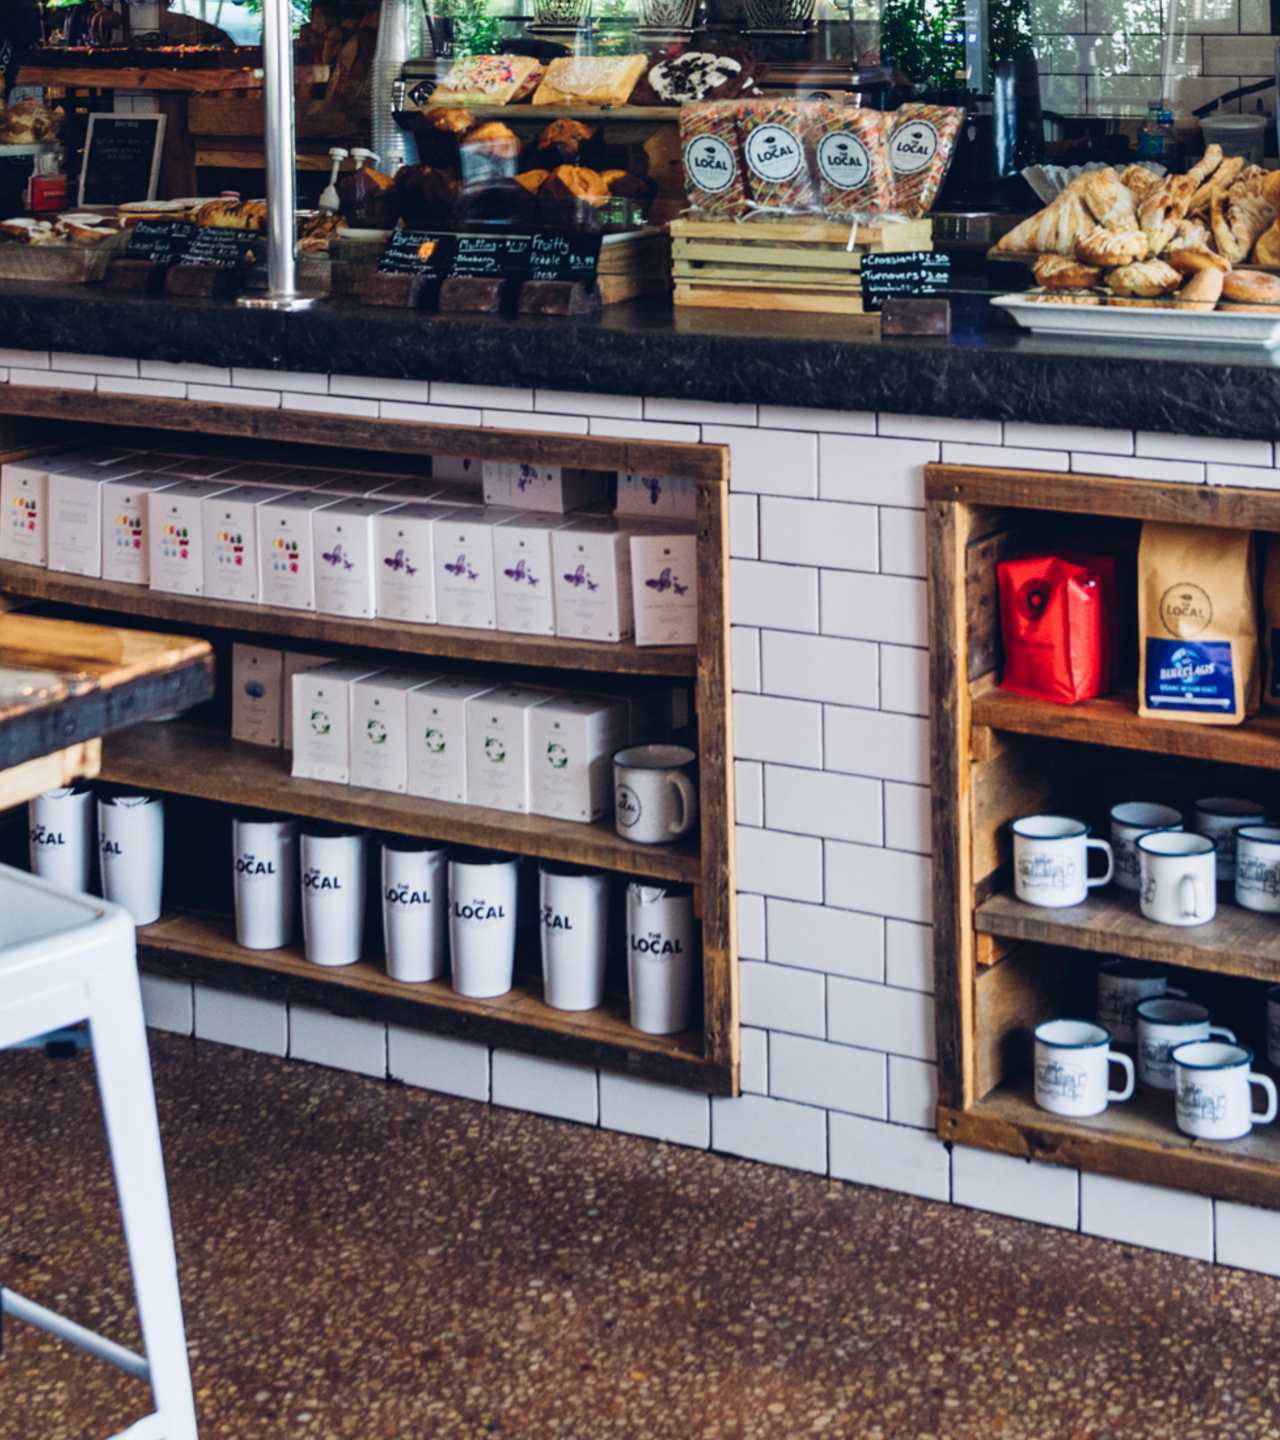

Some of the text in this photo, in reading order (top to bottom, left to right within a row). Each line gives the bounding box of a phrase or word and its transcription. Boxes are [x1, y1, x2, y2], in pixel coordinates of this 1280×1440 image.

[756, 147, 794, 163] LOCAL
[896, 141, 930, 156] LOCAL
[694, 157, 728, 171] LOCAL
[827, 154, 863, 168] LOCAL
[1166, 604, 1205, 618] LOCAL
[236, 859, 276, 875] OCAL
[304, 873, 341, 890] OCAL
[454, 902, 505, 920] LOCAL
[631, 936, 682, 955] LOCAL
